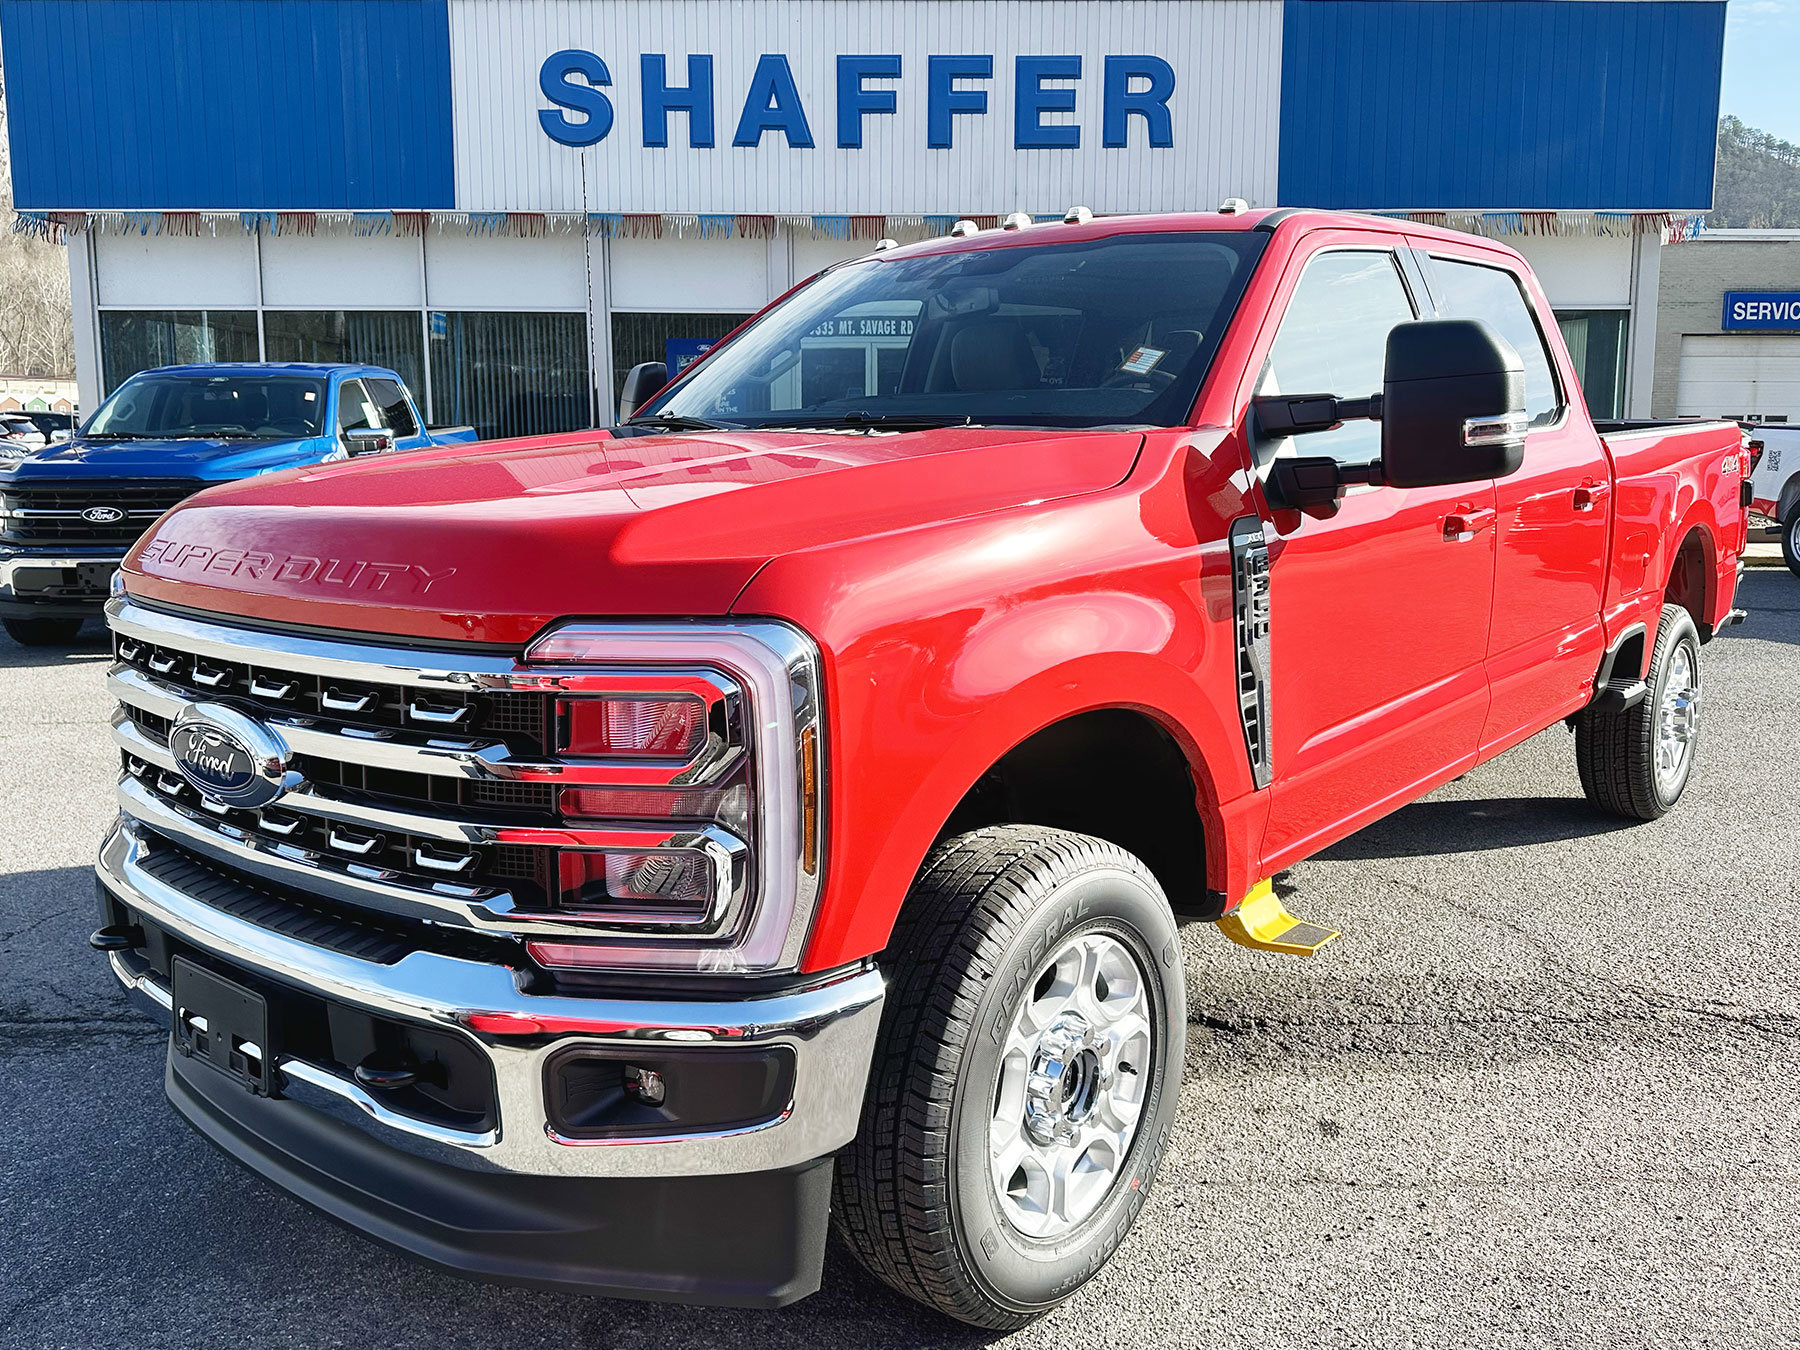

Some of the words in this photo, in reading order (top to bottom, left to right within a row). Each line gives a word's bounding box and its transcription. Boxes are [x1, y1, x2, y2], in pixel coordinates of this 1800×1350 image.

[538, 49, 1176, 151] SHAFFER
[839, 320, 855, 335] MT.
[860, 320, 896, 335] SAVAGE
[900, 320, 914, 335] RD
[89, 509, 115, 520] Ford
[138, 539, 275, 580] SUPER
[272, 554, 457, 594] DUTY
[185, 731, 235, 782] Ford
[990, 897, 1090, 1046] GENERAL
